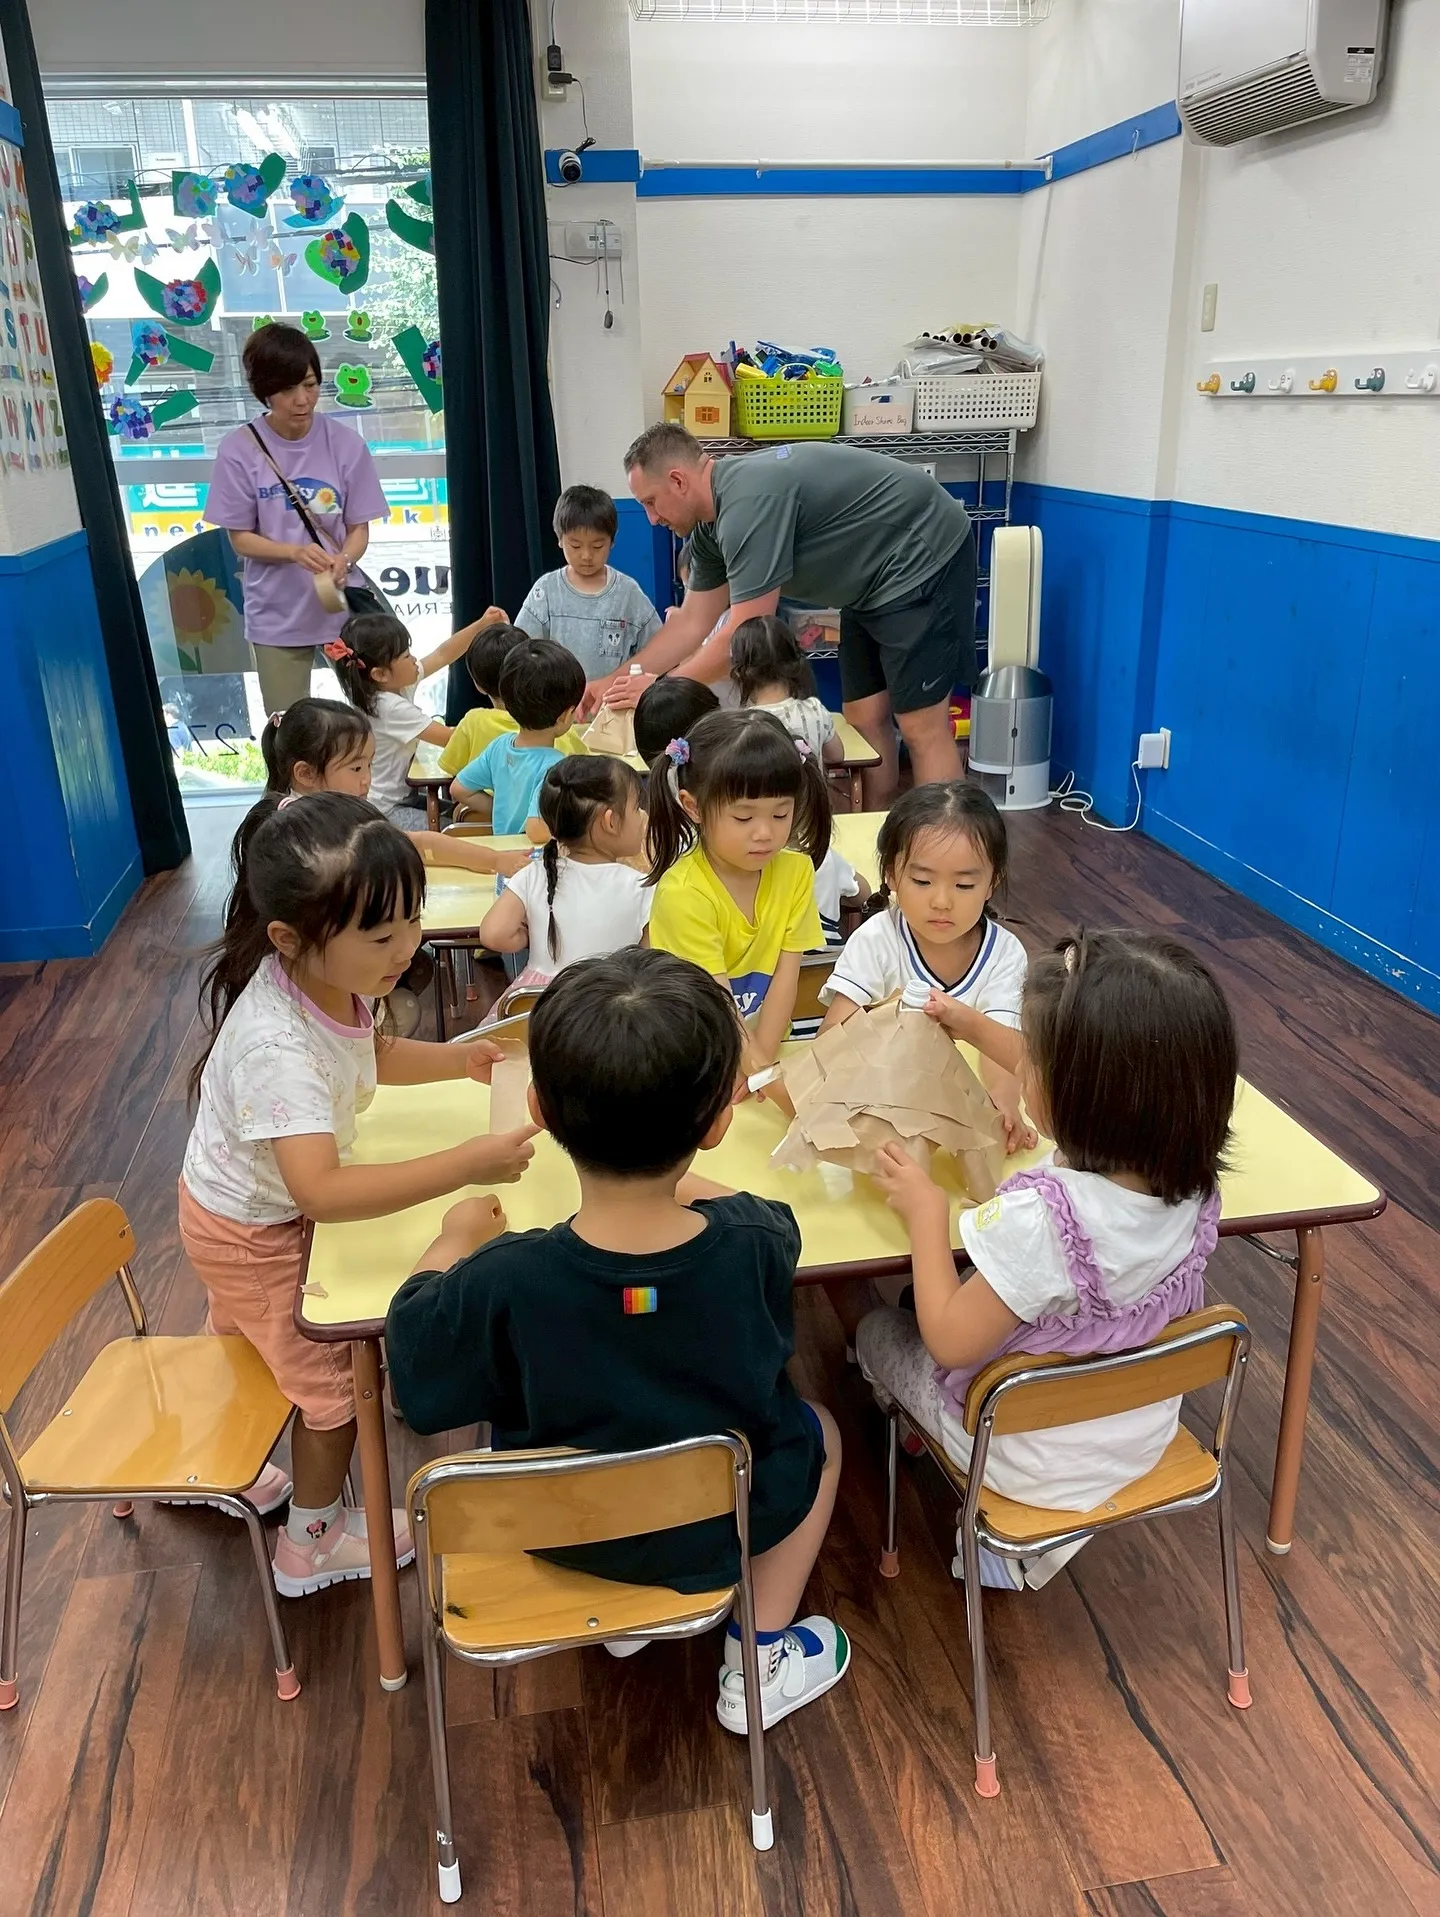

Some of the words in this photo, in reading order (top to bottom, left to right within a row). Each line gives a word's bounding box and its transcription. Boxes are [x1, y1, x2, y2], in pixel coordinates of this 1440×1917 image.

[4, 308, 17, 349] S
[19, 312, 31, 353] T
[34, 316, 47, 356] U
[3, 395, 19, 440] W
[22, 401, 36, 442] X
[34, 399, 45, 437] Y
[50, 399, 63, 437] Z
[897, 414, 907, 426] Bag
